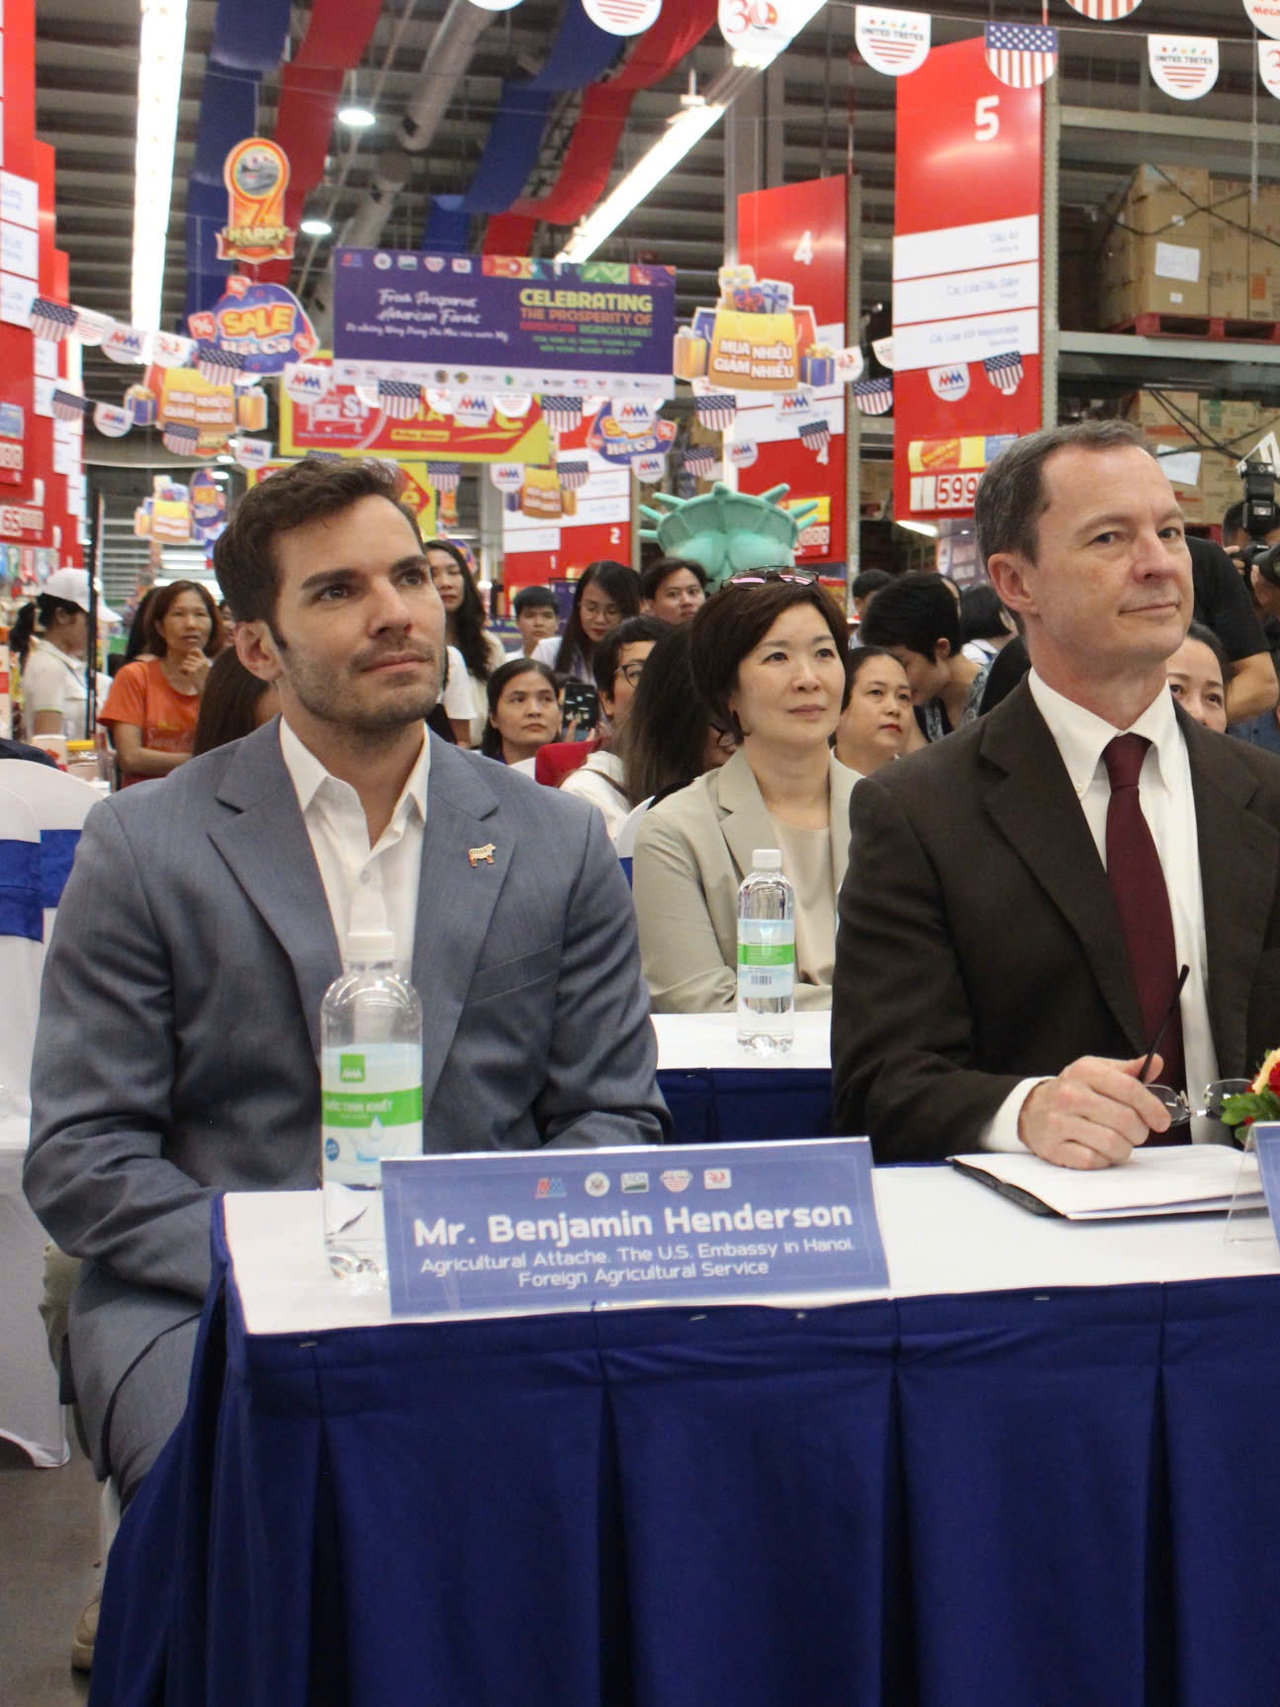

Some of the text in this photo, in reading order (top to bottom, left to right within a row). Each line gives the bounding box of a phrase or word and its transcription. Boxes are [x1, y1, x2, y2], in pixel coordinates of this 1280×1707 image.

[861, 27, 891, 38] UNITED
[1154, 55, 1183, 63] UNITED
[975, 94, 1000, 142] 5
[520, 288, 653, 312] CELEBRATING
[221, 304, 294, 339] SALE
[720, 340, 750, 356] MUA
[610, 527, 620, 544] 2
[413, 1202, 853, 1248] Mr. Benjamin Henderson
[421, 1253, 527, 1277] Agricultural
[616, 1246, 653, 1263] The
[657, 1245, 693, 1261] U.S.
[698, 1241, 778, 1259] Embassy
[784, 1240, 799, 1254] in
[519, 1260, 769, 1290] Foreign Agricultural Service
